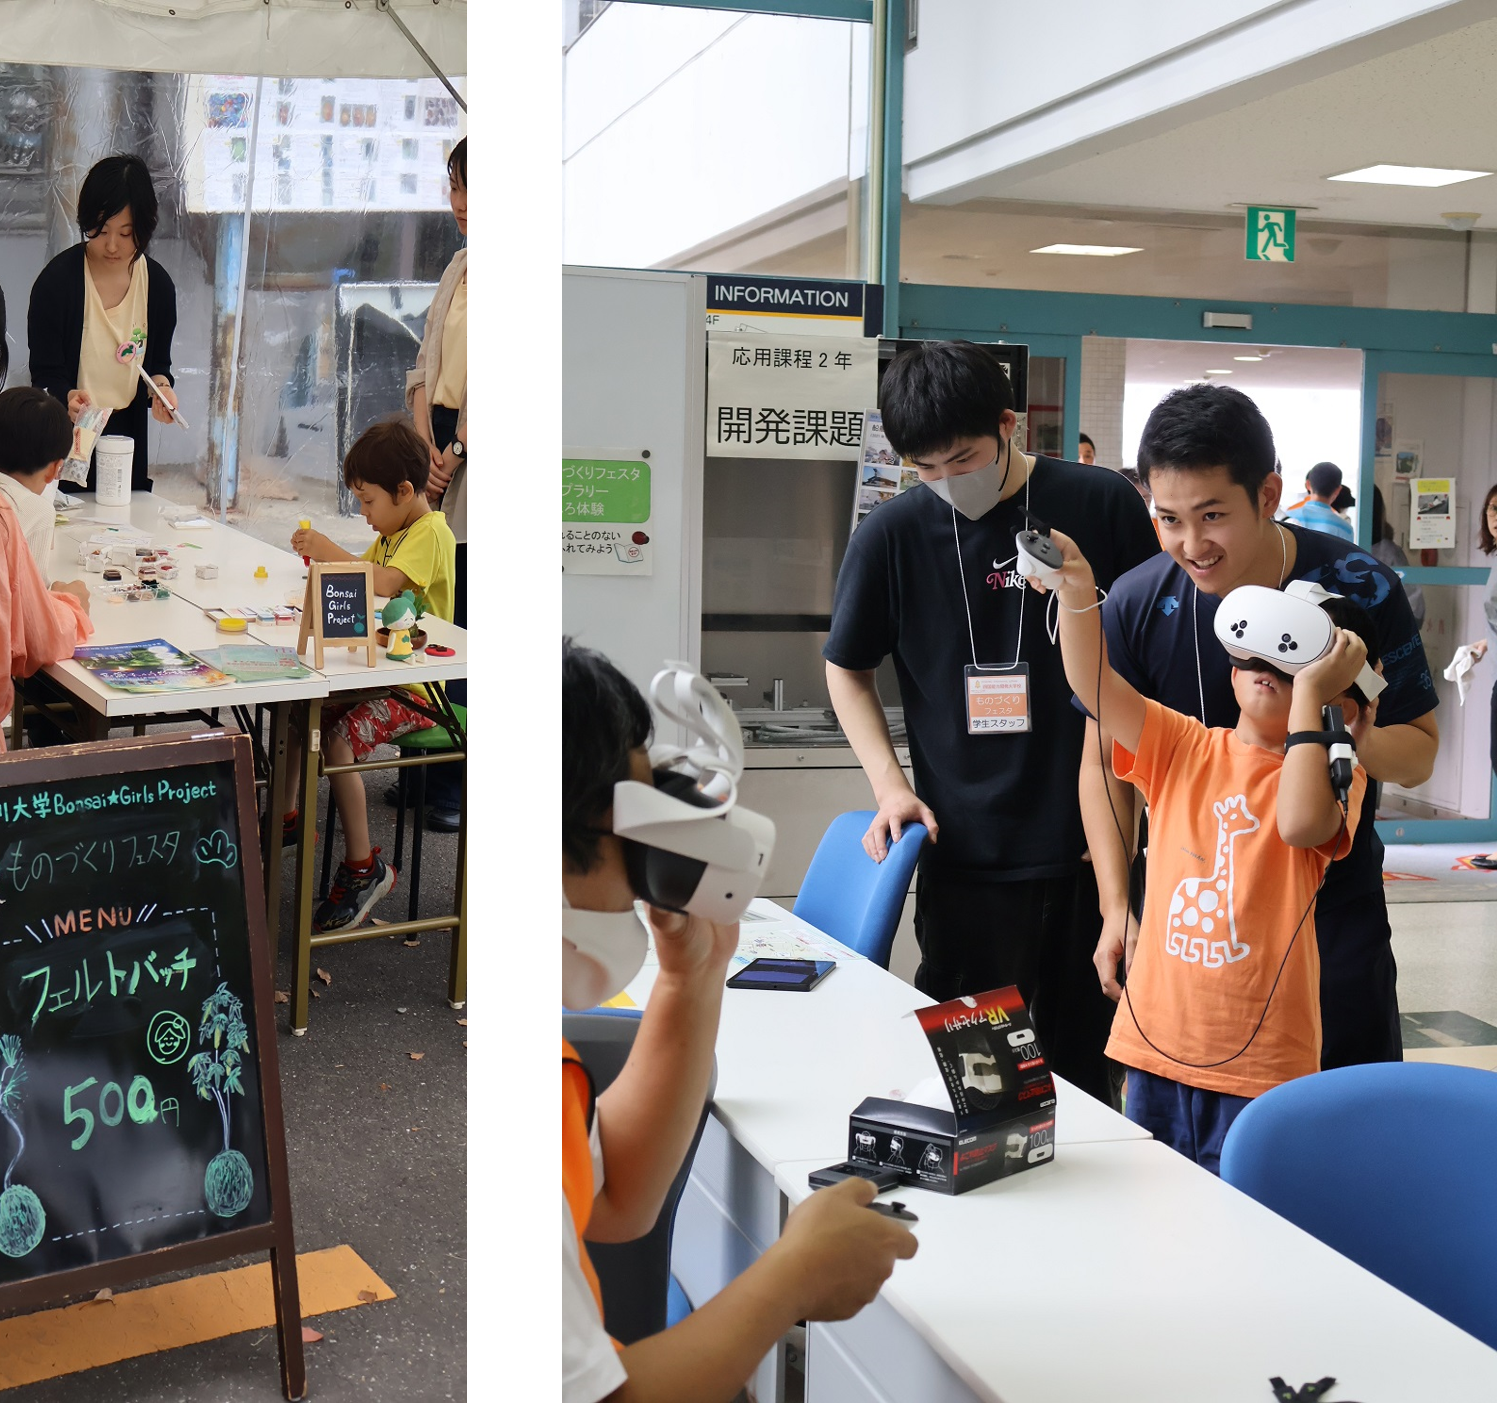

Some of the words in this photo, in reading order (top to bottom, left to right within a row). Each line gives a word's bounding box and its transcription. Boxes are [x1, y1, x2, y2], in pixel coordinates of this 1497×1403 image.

[714, 284, 849, 308] INFORMATION
[732, 346, 853, 371] 応用課程2年
[717, 406, 864, 447] 開発課題
[562, 465, 641, 481] づくりフェスタ
[562, 502, 604, 516] ろ体験
[986, 570, 1027, 590] Nike
[325, 584, 358, 599] Bonsai
[328, 600, 351, 611] Girls
[327, 612, 356, 626] Project
[976, 695, 1020, 706] ものづくり
[984, 707, 1013, 715] フェスタ
[972, 718, 1025, 729] 学生スタッフ
[157, 780, 217, 805] Project
[6, 830, 181, 892] ものづくりフェスタ
[53, 906, 133, 938] MENU
[19, 947, 198, 1026] フェルトバッチ
[943, 1004, 1011, 1033] VRアクセサリ
[63, 1074, 181, 1150] 500円
[1029, 1129, 1049, 1149] 100
